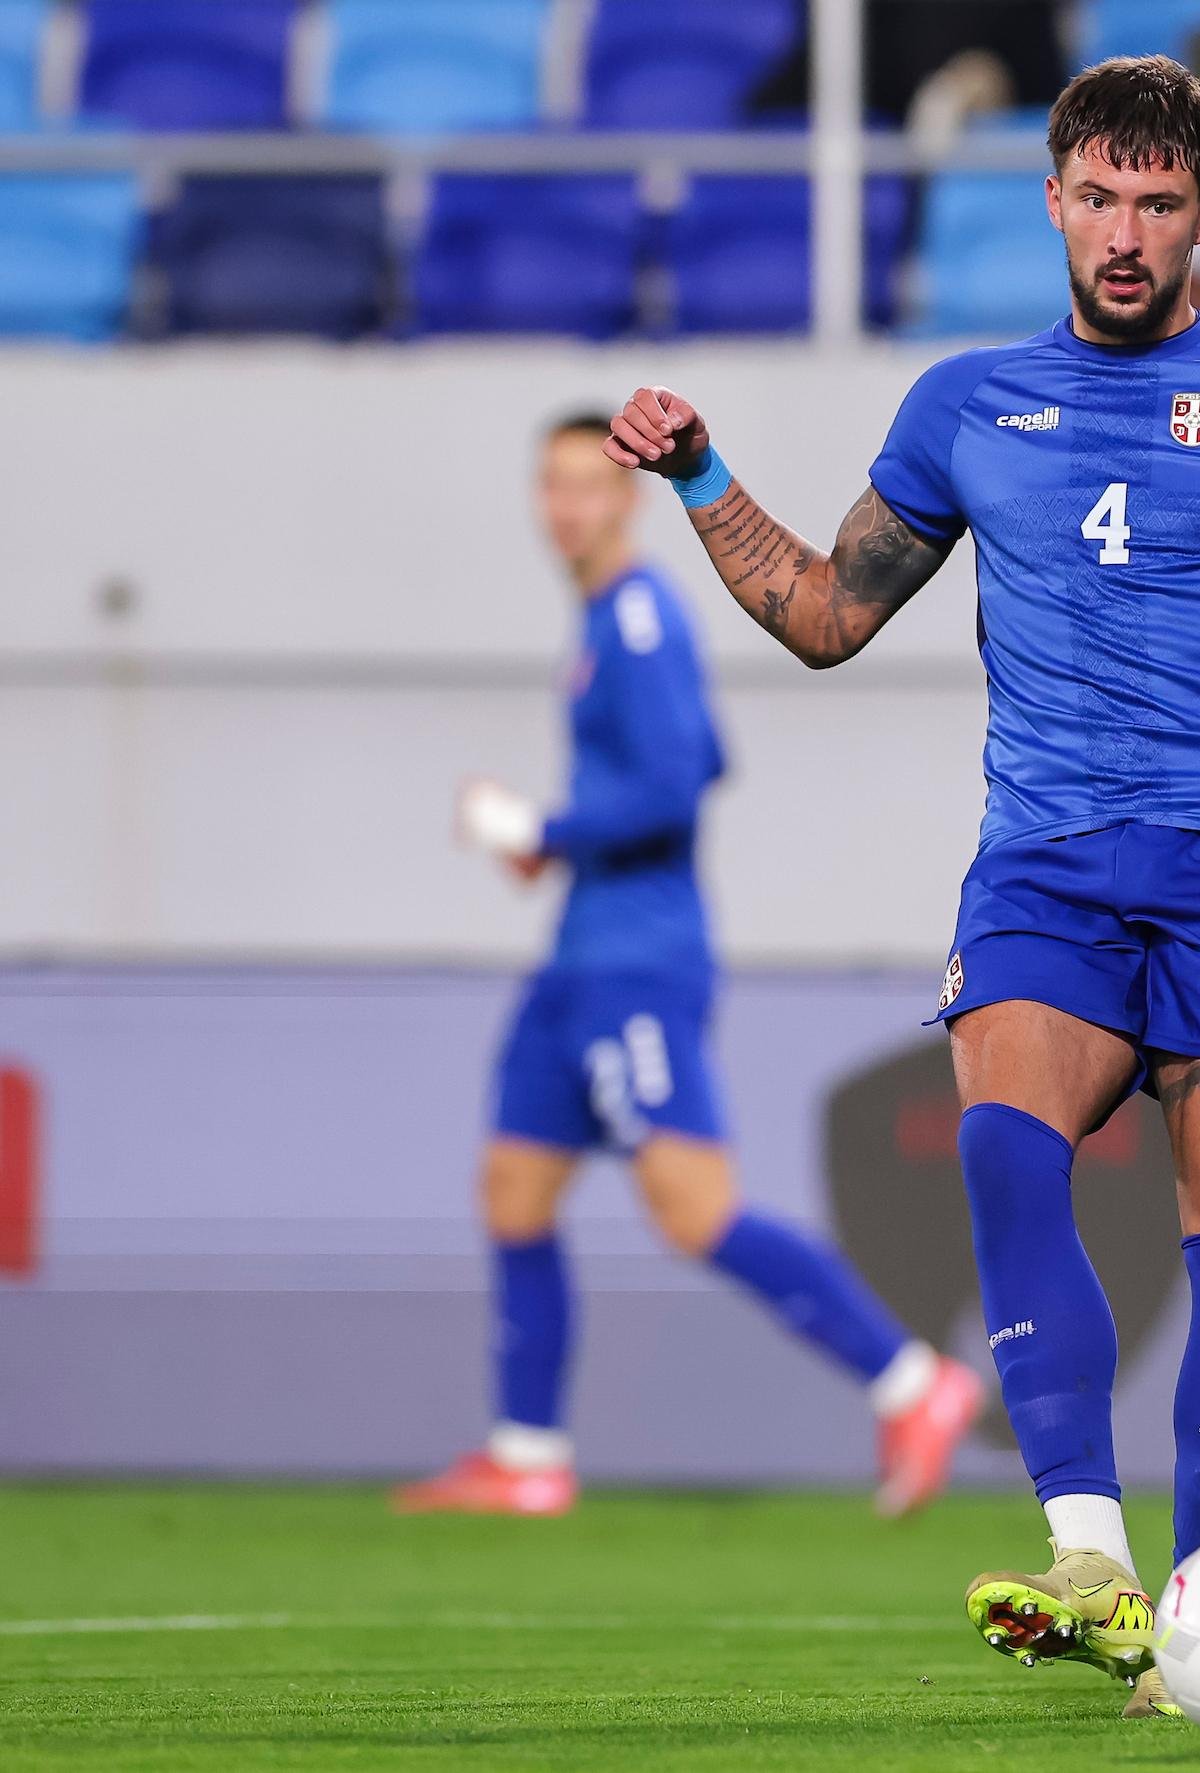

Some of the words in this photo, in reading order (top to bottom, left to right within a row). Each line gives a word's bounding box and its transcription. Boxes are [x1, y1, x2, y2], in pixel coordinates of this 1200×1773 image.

[996, 406, 1060, 430] capelli
[1023, 423, 1059, 432] SPORT
[1080, 482, 1131, 565] 4
